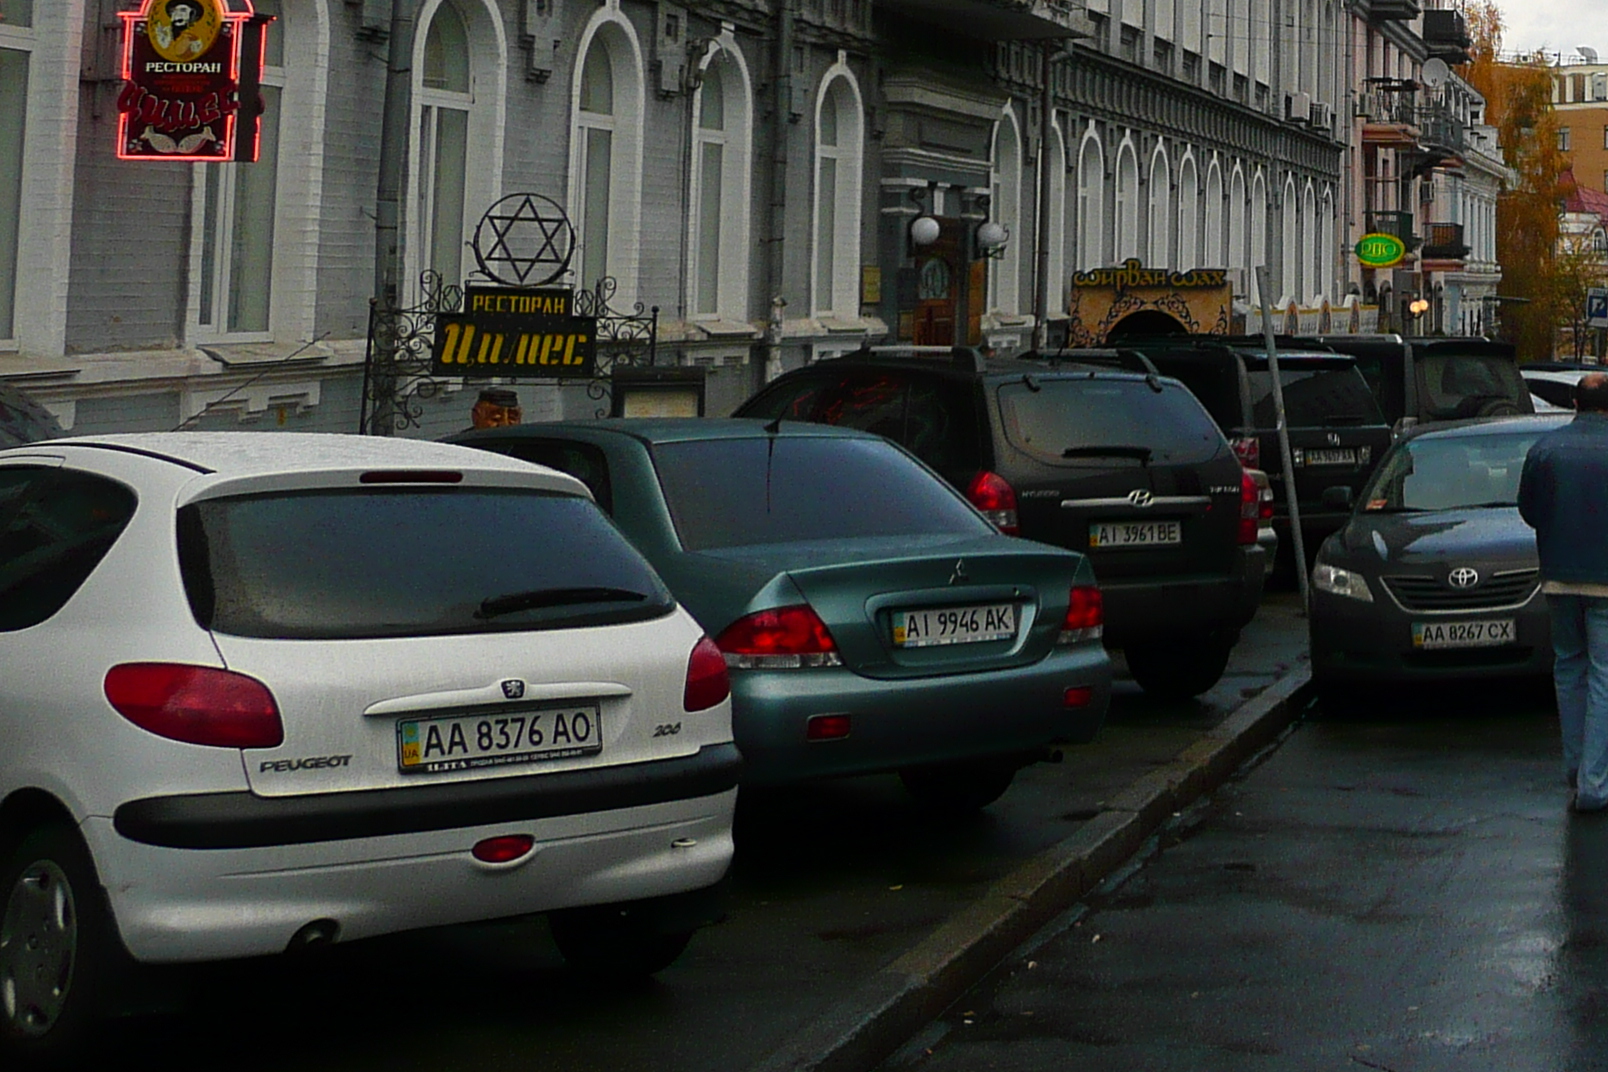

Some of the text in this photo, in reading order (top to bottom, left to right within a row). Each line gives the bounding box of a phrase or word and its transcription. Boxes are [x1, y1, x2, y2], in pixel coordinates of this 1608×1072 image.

[145, 62, 222, 73] РЕСТОРАН
[472, 294, 565, 314] РЕСТОРАН
[1099, 523, 1177, 543] AI 3961 BE
[907, 607, 1010, 638] AI 9946 AK
[1423, 622, 1510, 642] AA 8267 CX
[424, 722, 469, 758] AA
[476, 715, 544, 751] 8376
[552, 712, 592, 745] AO
[652, 721, 681, 738] 206
[259, 754, 354, 773] PEUGEOT
[404, 749, 419, 759] UA
